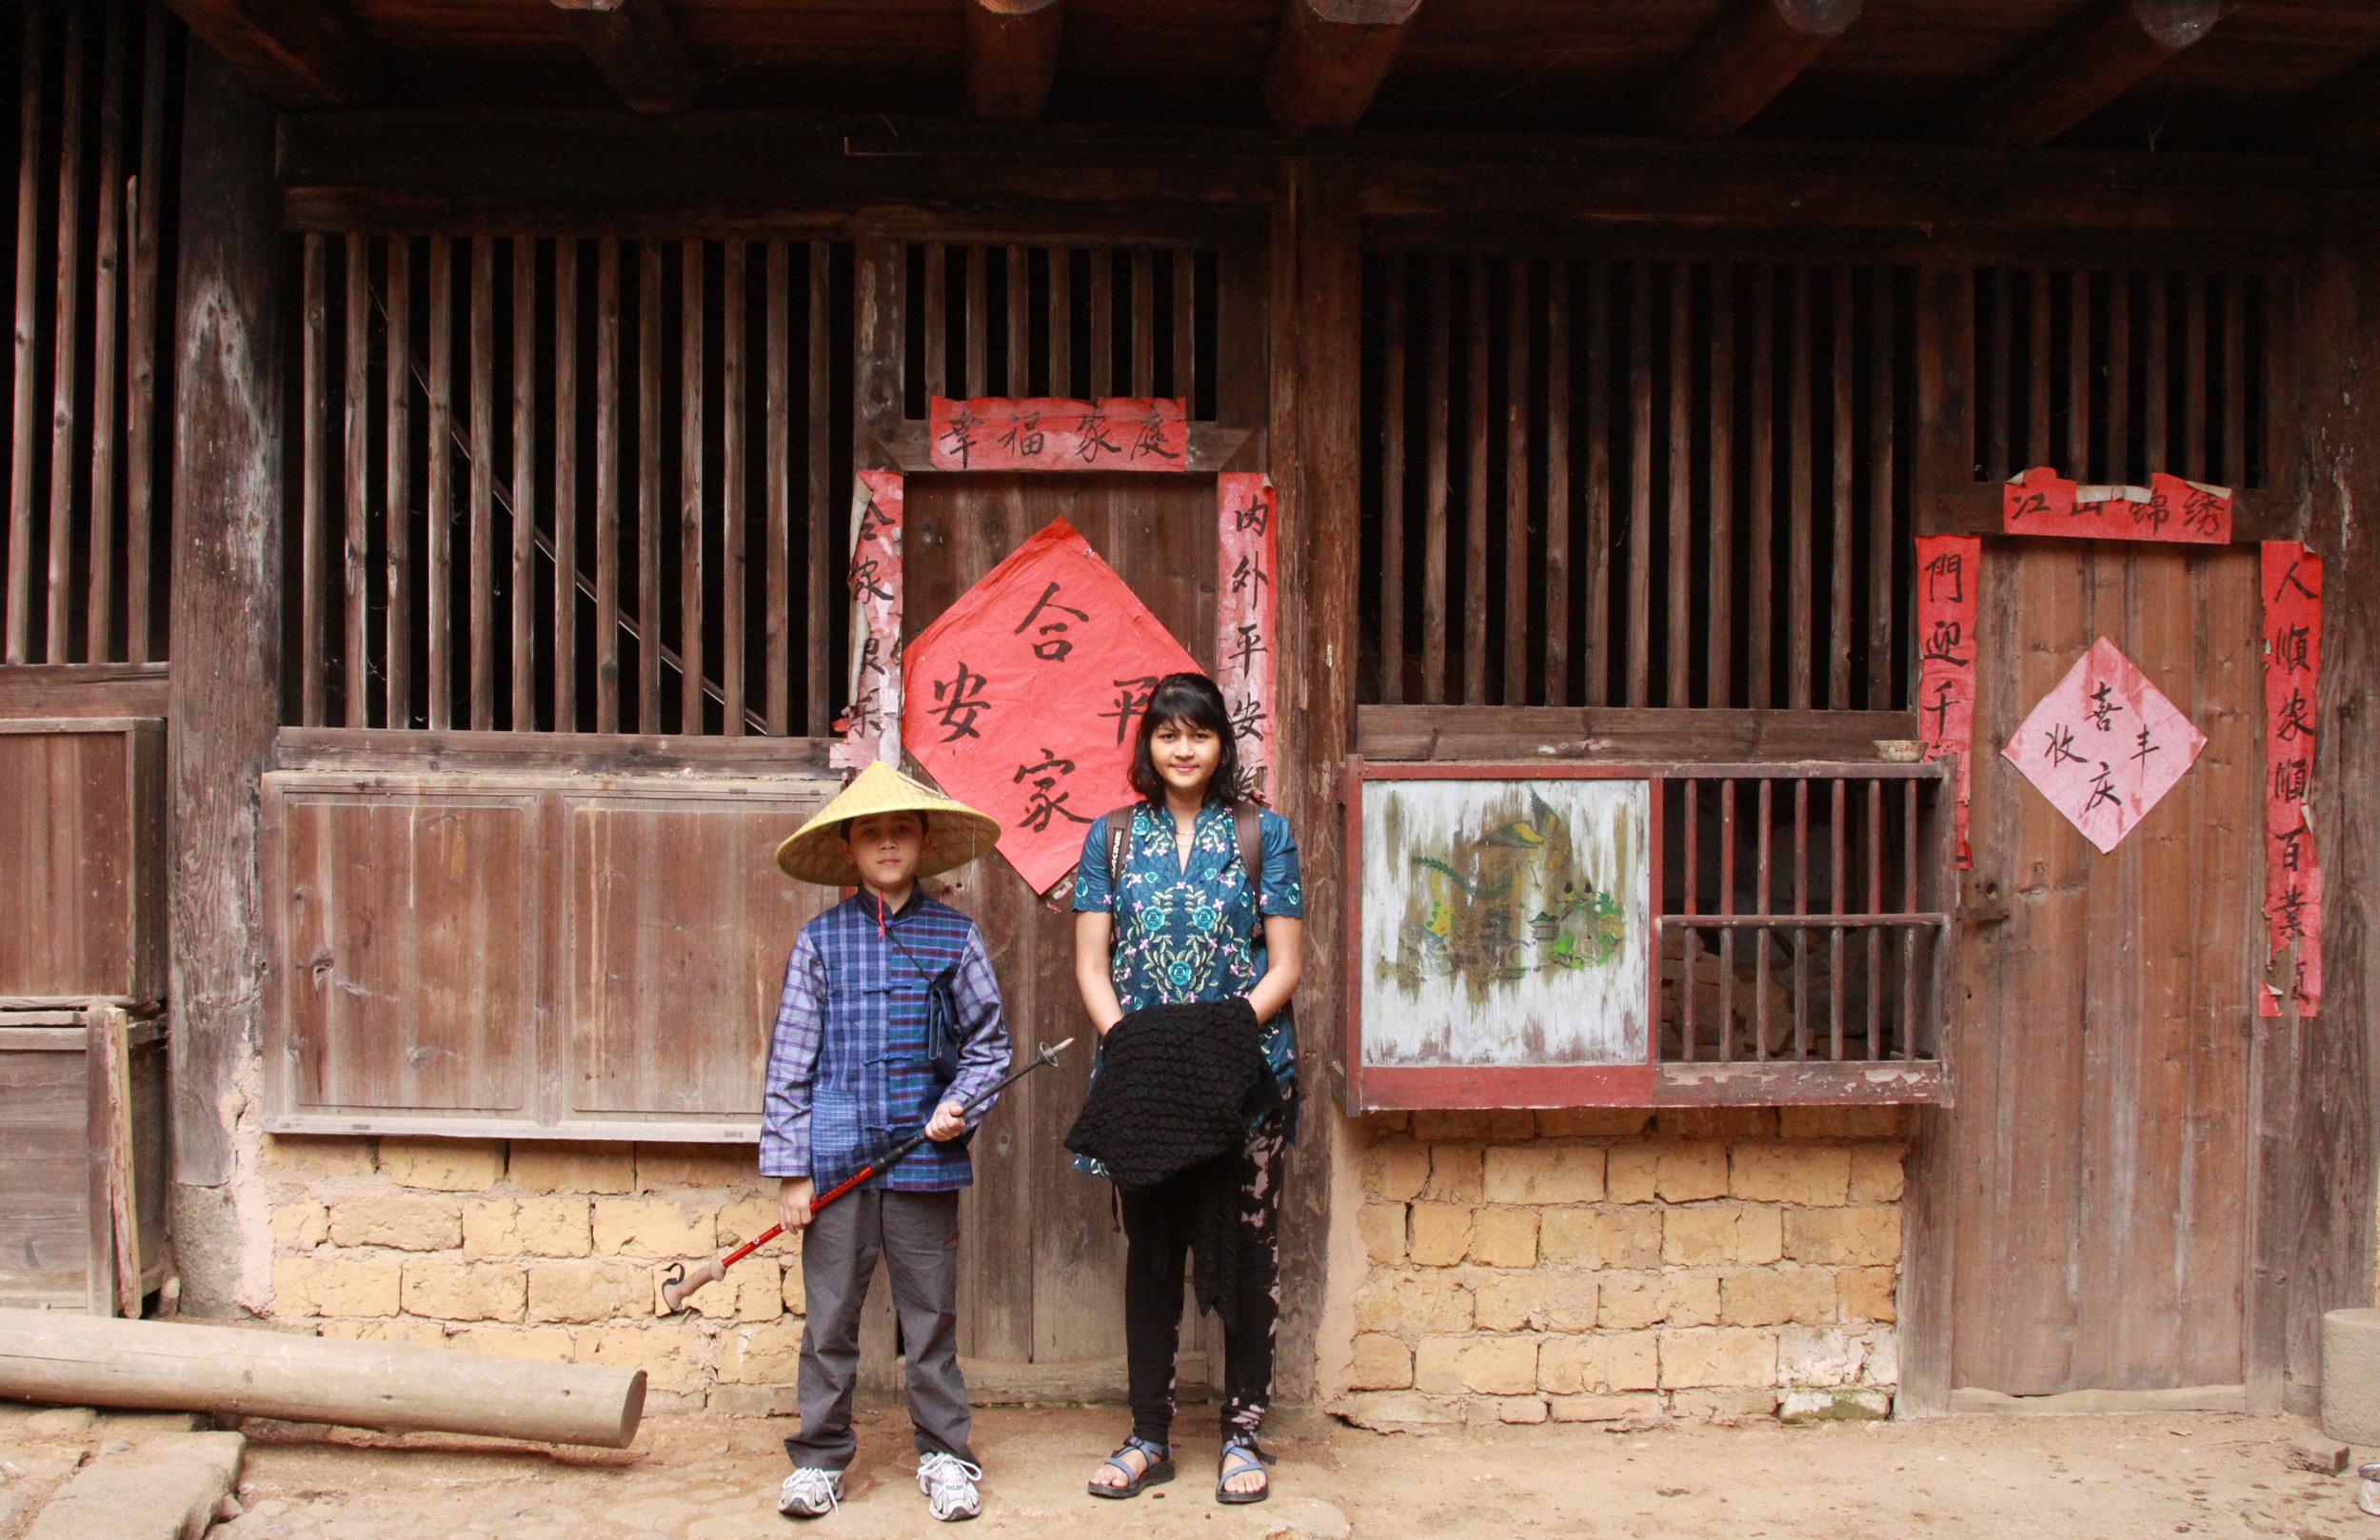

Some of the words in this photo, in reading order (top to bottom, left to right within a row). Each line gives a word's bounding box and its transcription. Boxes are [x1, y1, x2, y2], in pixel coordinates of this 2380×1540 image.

[940, 405, 1180, 469] 幸福家庭
[1014, 582, 1089, 662] 合
[1923, 553, 1969, 759] 門迎千
[927, 661, 992, 744] 安
[2084, 681, 2123, 732] 喜
[2044, 722, 2089, 768] 收
[1012, 747, 1095, 834] 家
[2084, 761, 2122, 814] 庆
